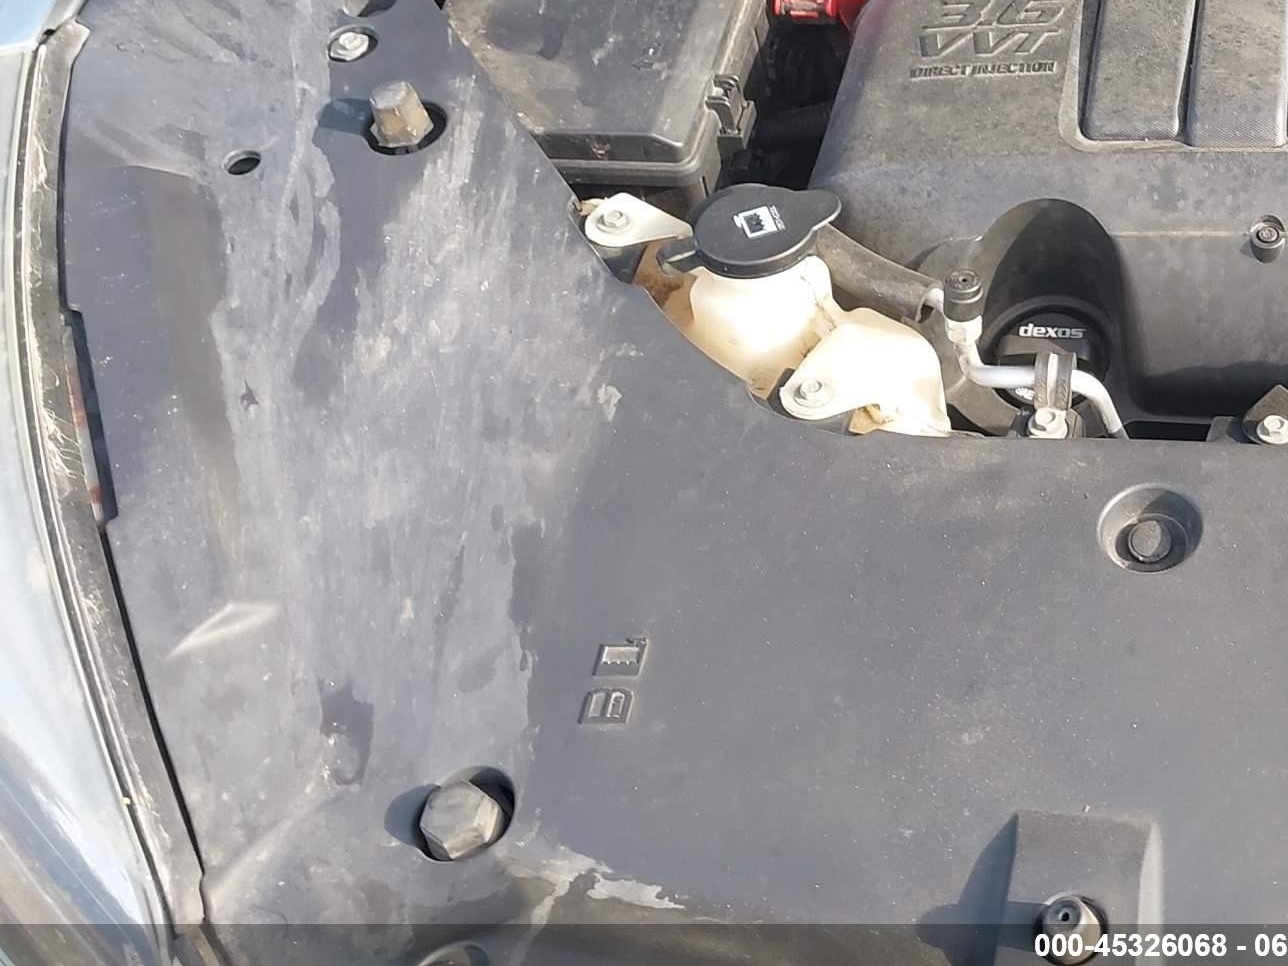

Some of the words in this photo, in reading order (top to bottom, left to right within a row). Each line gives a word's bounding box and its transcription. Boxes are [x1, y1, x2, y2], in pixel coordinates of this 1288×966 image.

[919, 30, 1062, 59] VVT
[910, 65, 972, 81] DIRECT
[972, 61, 1057, 77] INJECTION
[1019, 322, 1087, 339] dexos
